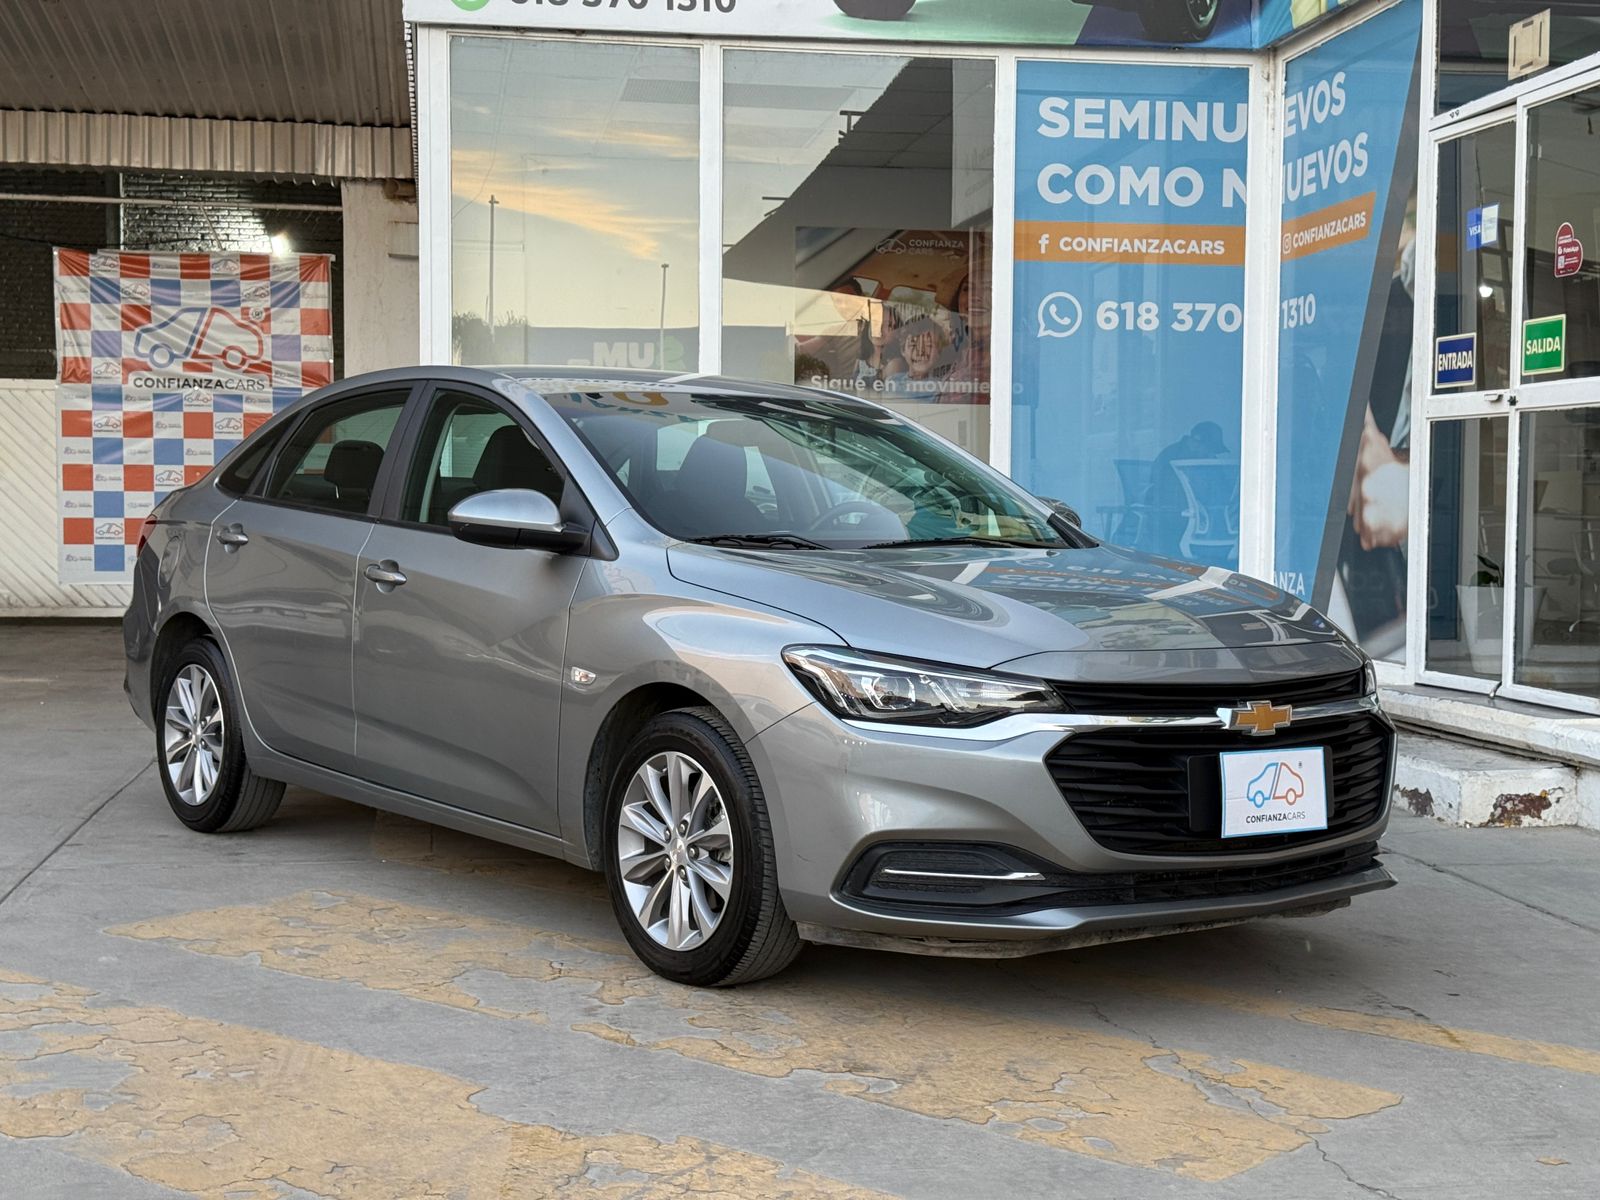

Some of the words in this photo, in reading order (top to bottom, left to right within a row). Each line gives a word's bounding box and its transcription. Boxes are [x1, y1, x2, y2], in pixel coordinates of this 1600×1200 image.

[1284, 71, 1346, 138] EVOS
[1037, 97, 1247, 143] SEMINU
[1037, 163, 1204, 207] COMO
[1292, 211, 1366, 248] CONFIANZACARS
[1059, 236, 1225, 255] CONFIANZACARS
[1096, 301, 1160, 331] 618
[1171, 303, 1242, 332] 370
[1282, 294, 1316, 329] 1310
[1525, 337, 1561, 355] SALIDA
[1438, 349, 1473, 371] ENTRADA
[133, 376, 265, 391] CONFIANZACARS
[810, 374, 866, 391] Sigue
[872, 379, 896, 392] en
[1245, 811, 1306, 824] CONFIANZACARS
